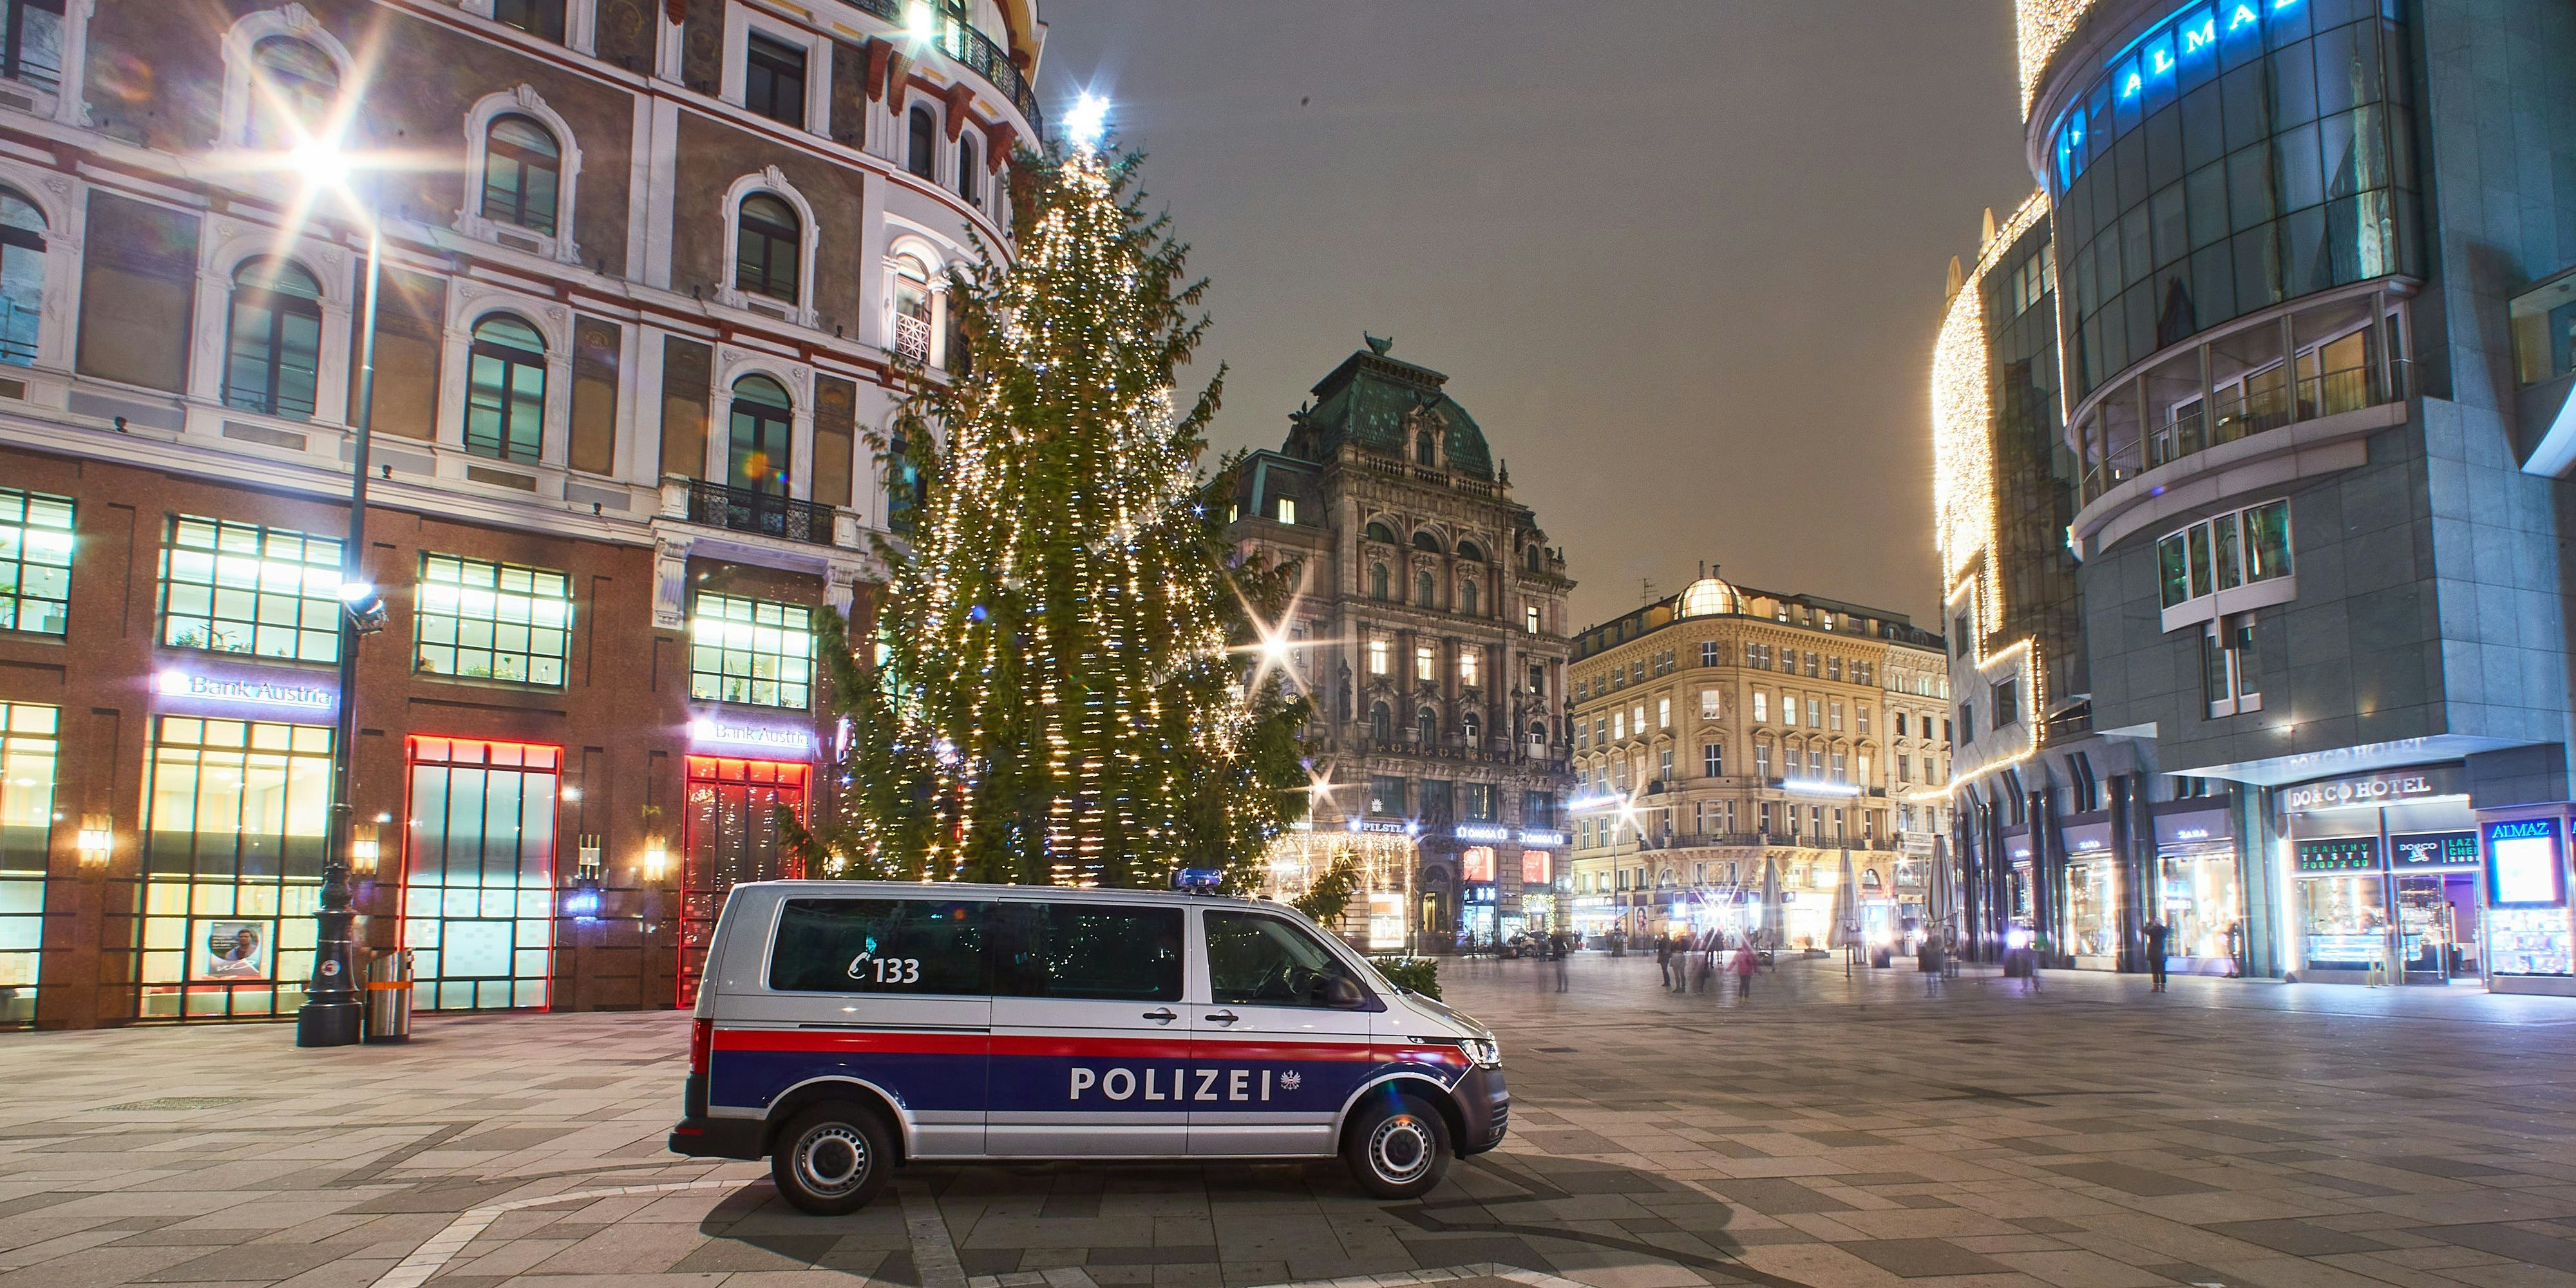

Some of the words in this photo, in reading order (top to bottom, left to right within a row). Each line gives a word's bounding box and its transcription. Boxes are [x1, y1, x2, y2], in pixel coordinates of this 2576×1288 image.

[193, 676, 254, 697] Bank
[257, 682, 333, 706] Austria
[716, 723, 756, 741] Bank
[759, 728, 809, 745] Austria
[2355, 776, 2432, 799] HOTEL
[1363, 822, 1405, 833] PILSTL
[2492, 822, 2550, 838] ALMAZ
[2302, 844, 2367, 853] HEALTHY
[2302, 851, 2369, 862] TASTY
[2302, 861, 2334, 869] FOOD
[873, 958, 920, 983] 133
[1070, 1068, 1271, 1101] POLIZEI
